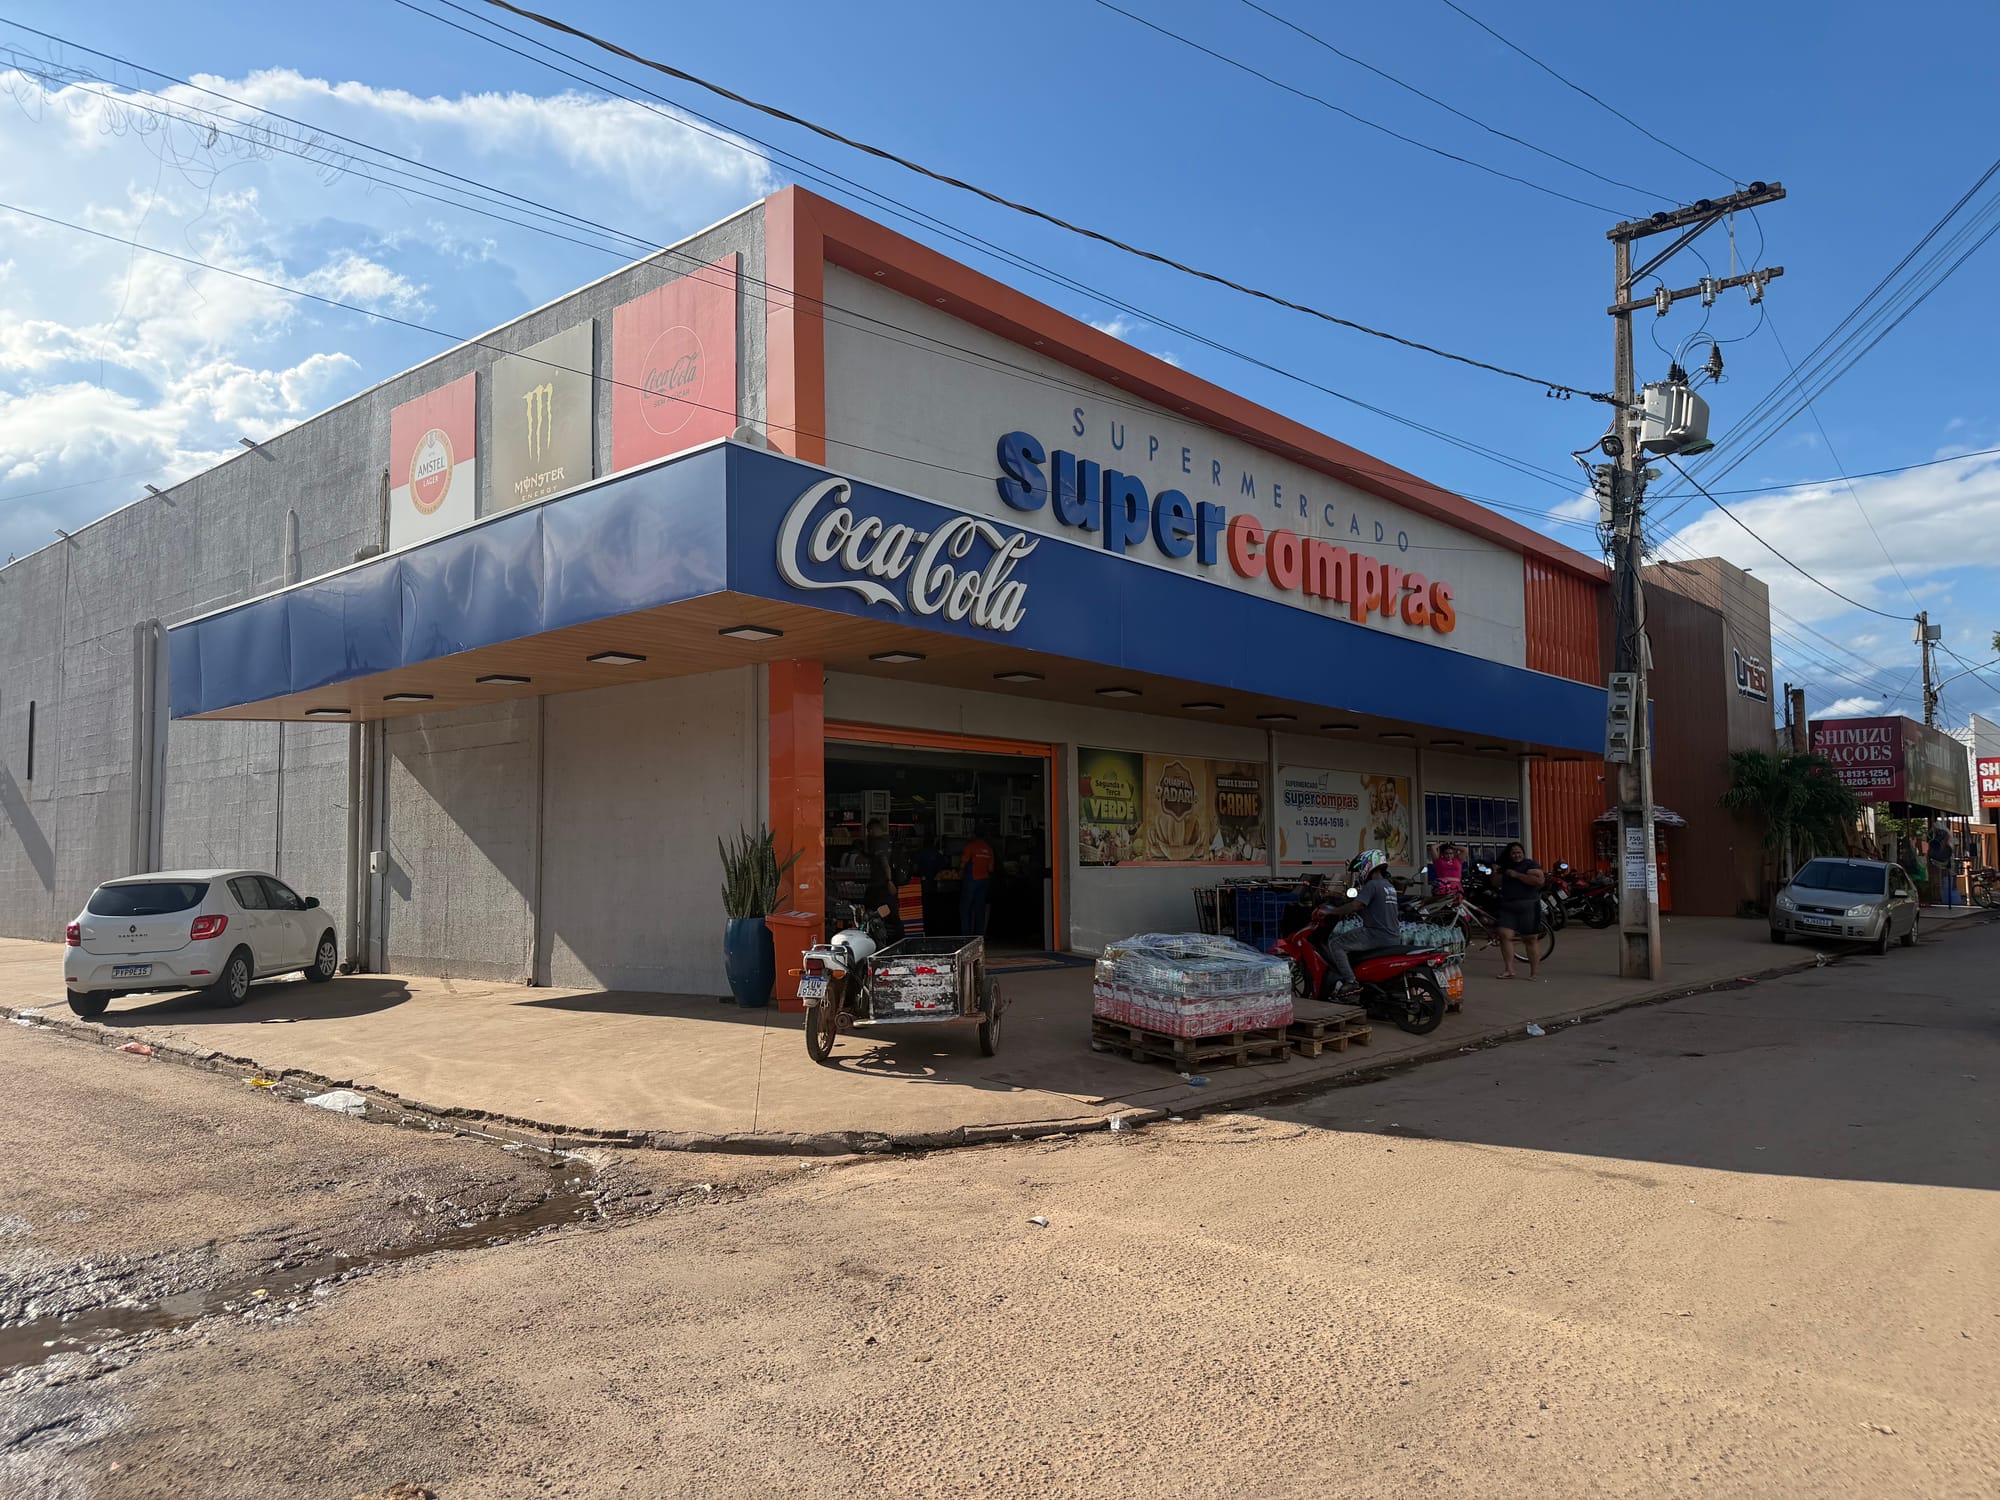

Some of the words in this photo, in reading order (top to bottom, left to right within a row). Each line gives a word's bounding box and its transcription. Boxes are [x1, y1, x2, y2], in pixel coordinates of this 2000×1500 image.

[644, 352, 698, 400] Coca-Cola
[417, 456, 446, 478] AMSTEL
[1072, 407, 1409, 552] SUPERMERCADO
[423, 475, 439, 487] LAGER
[514, 467, 566, 494] MONSTER
[995, 430, 1456, 633] supercompras
[776, 477, 1041, 632] Coca-Cola
[1814, 727, 1892, 745] SHIMIZU
[1090, 798, 1135, 821] VERDE
[1218, 792, 1258, 817] CARNE
[1284, 791, 1359, 810] supercompras
